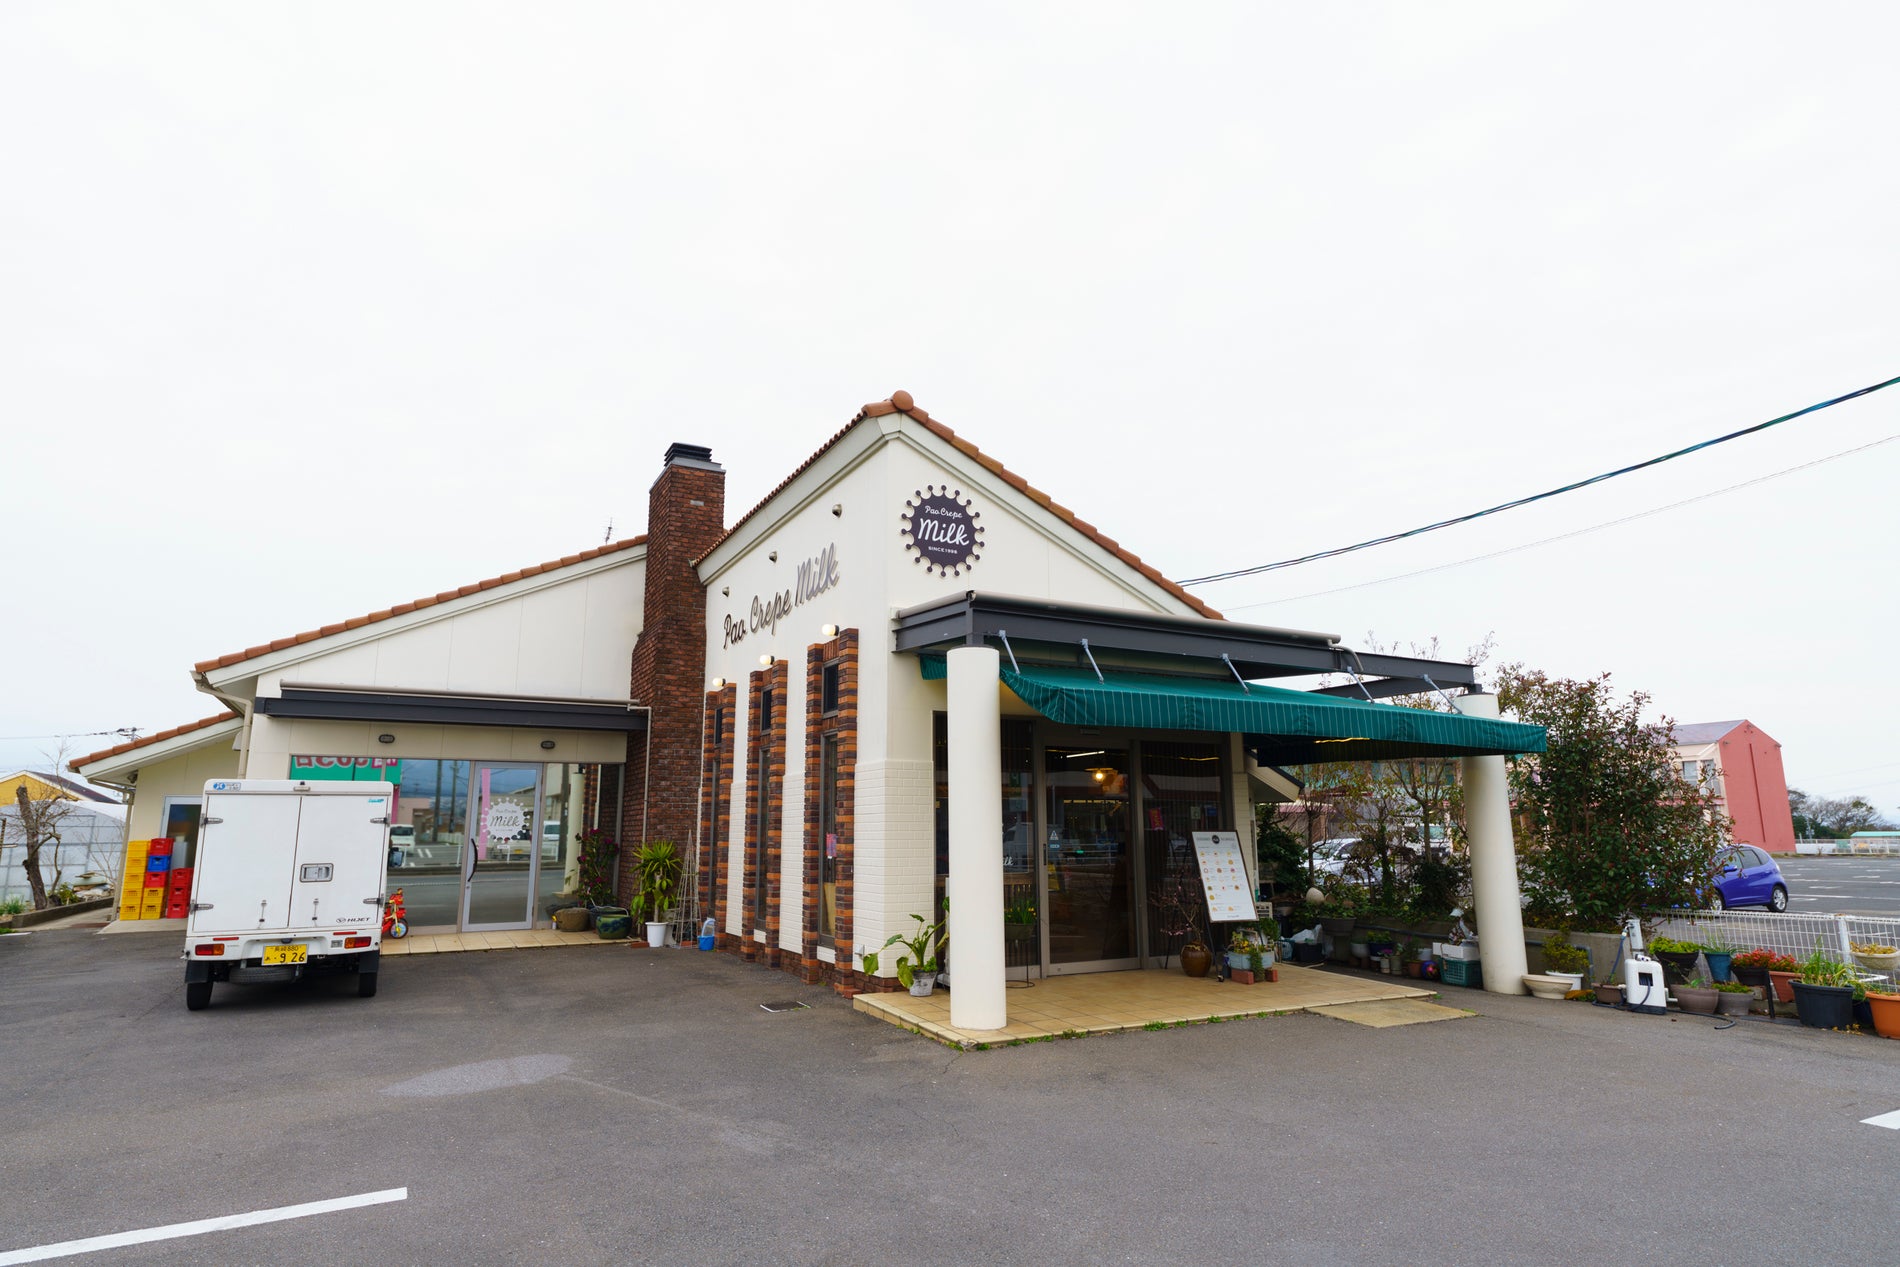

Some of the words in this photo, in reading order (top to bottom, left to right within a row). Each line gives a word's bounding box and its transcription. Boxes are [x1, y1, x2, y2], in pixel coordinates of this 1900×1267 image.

[925, 505, 940, 514] Pao
[940, 507, 963, 520] Crepe
[917, 517, 970, 546] Milk
[723, 613, 747, 650] Pao
[750, 588, 793, 637] Crepe
[794, 541, 840, 608] Milk
[489, 815, 520, 827] Milk
